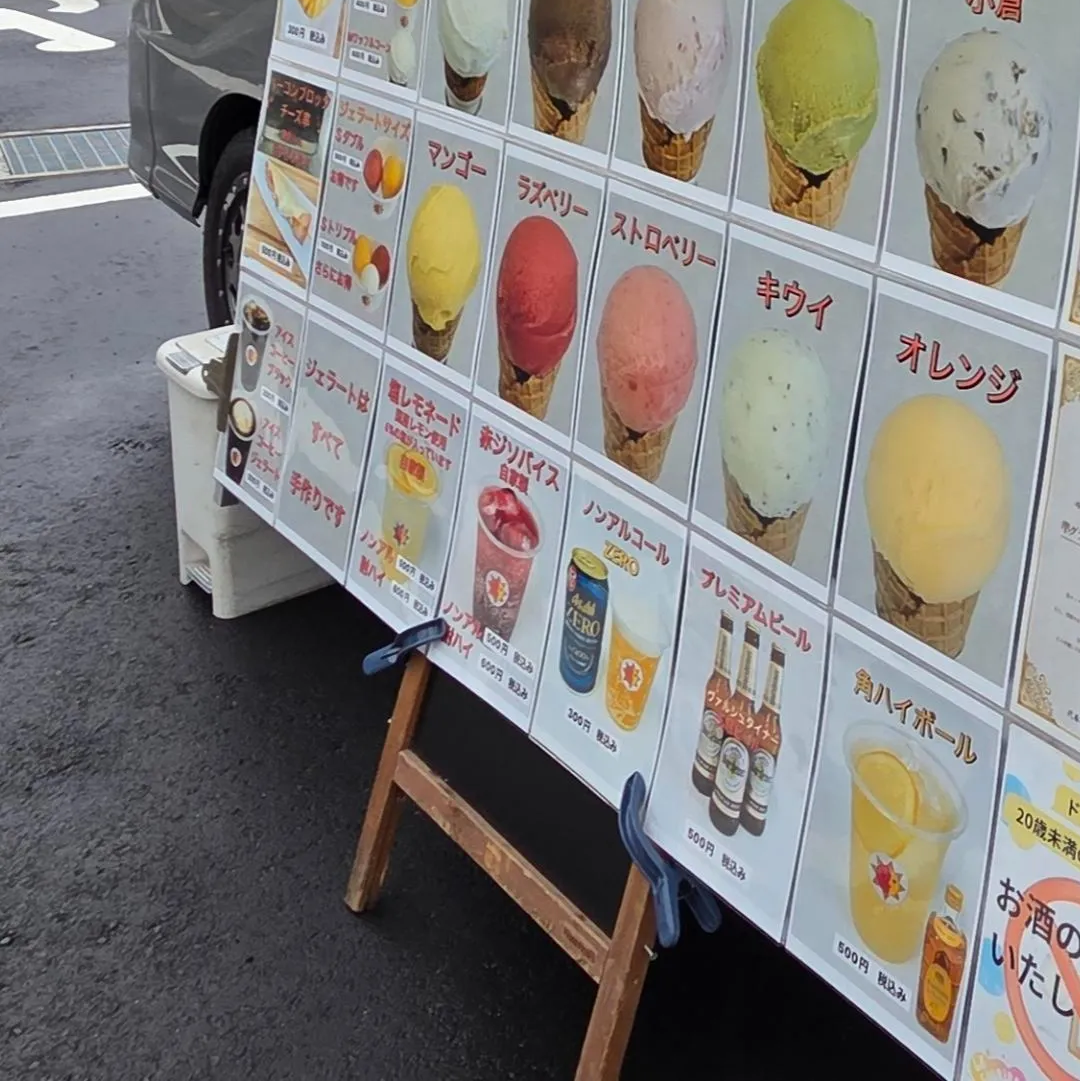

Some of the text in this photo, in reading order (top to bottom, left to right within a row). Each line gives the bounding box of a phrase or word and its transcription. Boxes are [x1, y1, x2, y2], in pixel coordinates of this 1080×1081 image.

[337, 100, 412, 142] ジェラートサイズ
[427, 139, 488, 180] マンゴー
[516, 174, 589, 218] ラズベリー
[610, 211, 717, 267] ストロベリー
[756, 270, 834, 331] キウイ
[304, 357, 371, 414] ジェラートは
[895, 332, 1022, 404] オレンジ
[387, 377, 462, 438] 塩レモネード
[311, 420, 345, 461] すべて
[478, 424, 561, 493] 赤ジソバイス
[290, 470, 347, 528] 手作りです
[583, 500, 671, 567] ノンアルコール
[603, 539, 640, 577] ZERO
[565, 606, 601, 638] ZERO
[701, 567, 813, 653] プレミアムビール
[853, 667, 979, 764] 角ハイボール
[687, 827, 715, 857] 500円
[837, 939, 870, 975] 500円
[877, 970, 908, 1003] 税込み
